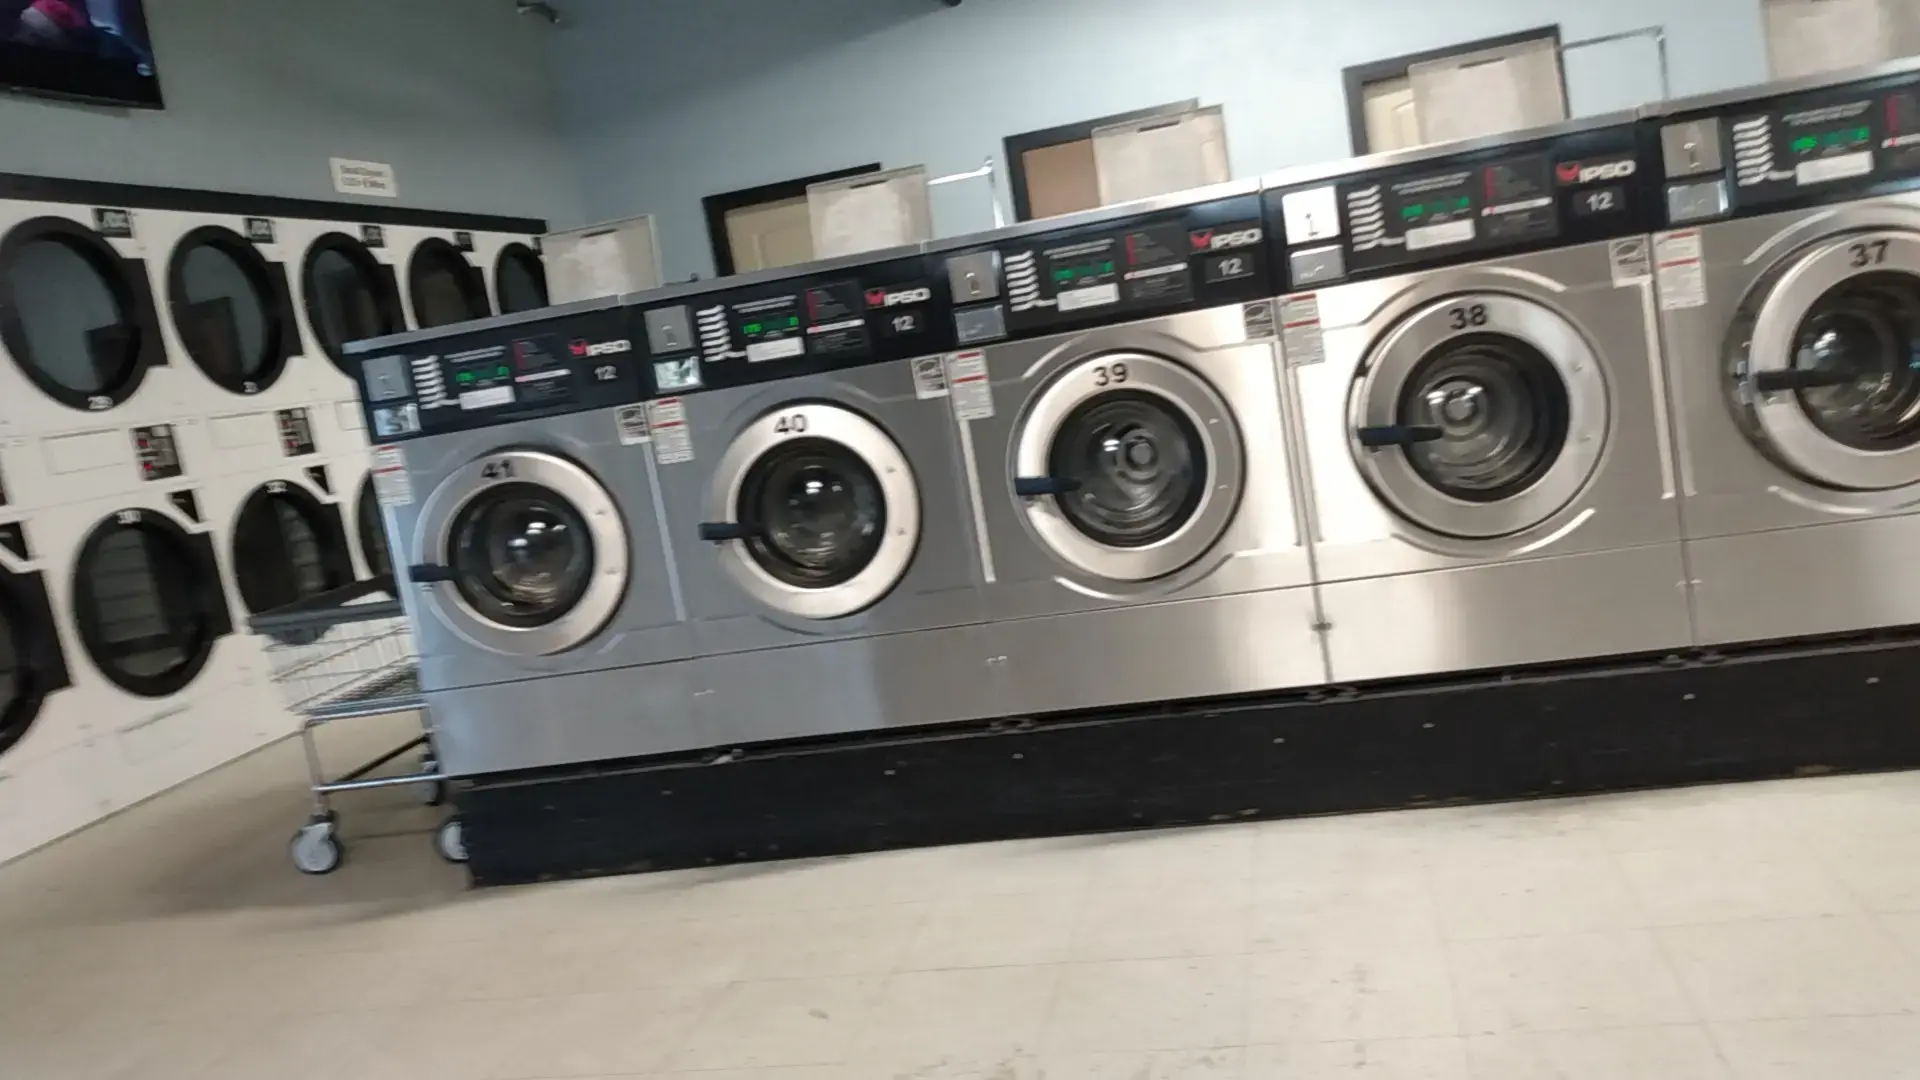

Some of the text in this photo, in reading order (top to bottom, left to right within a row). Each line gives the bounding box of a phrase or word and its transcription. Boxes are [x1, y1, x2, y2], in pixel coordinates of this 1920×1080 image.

[1586, 192, 1613, 212] 12
[1848, 239, 1892, 268] 37
[1219, 257, 1243, 276] 12
[892, 315, 917, 332] 12
[1448, 303, 1489, 330] 38
[594, 365, 618, 380] 12
[1092, 362, 1128, 387] 39
[774, 413, 808, 434] 40
[481, 459, 515, 479] 41
